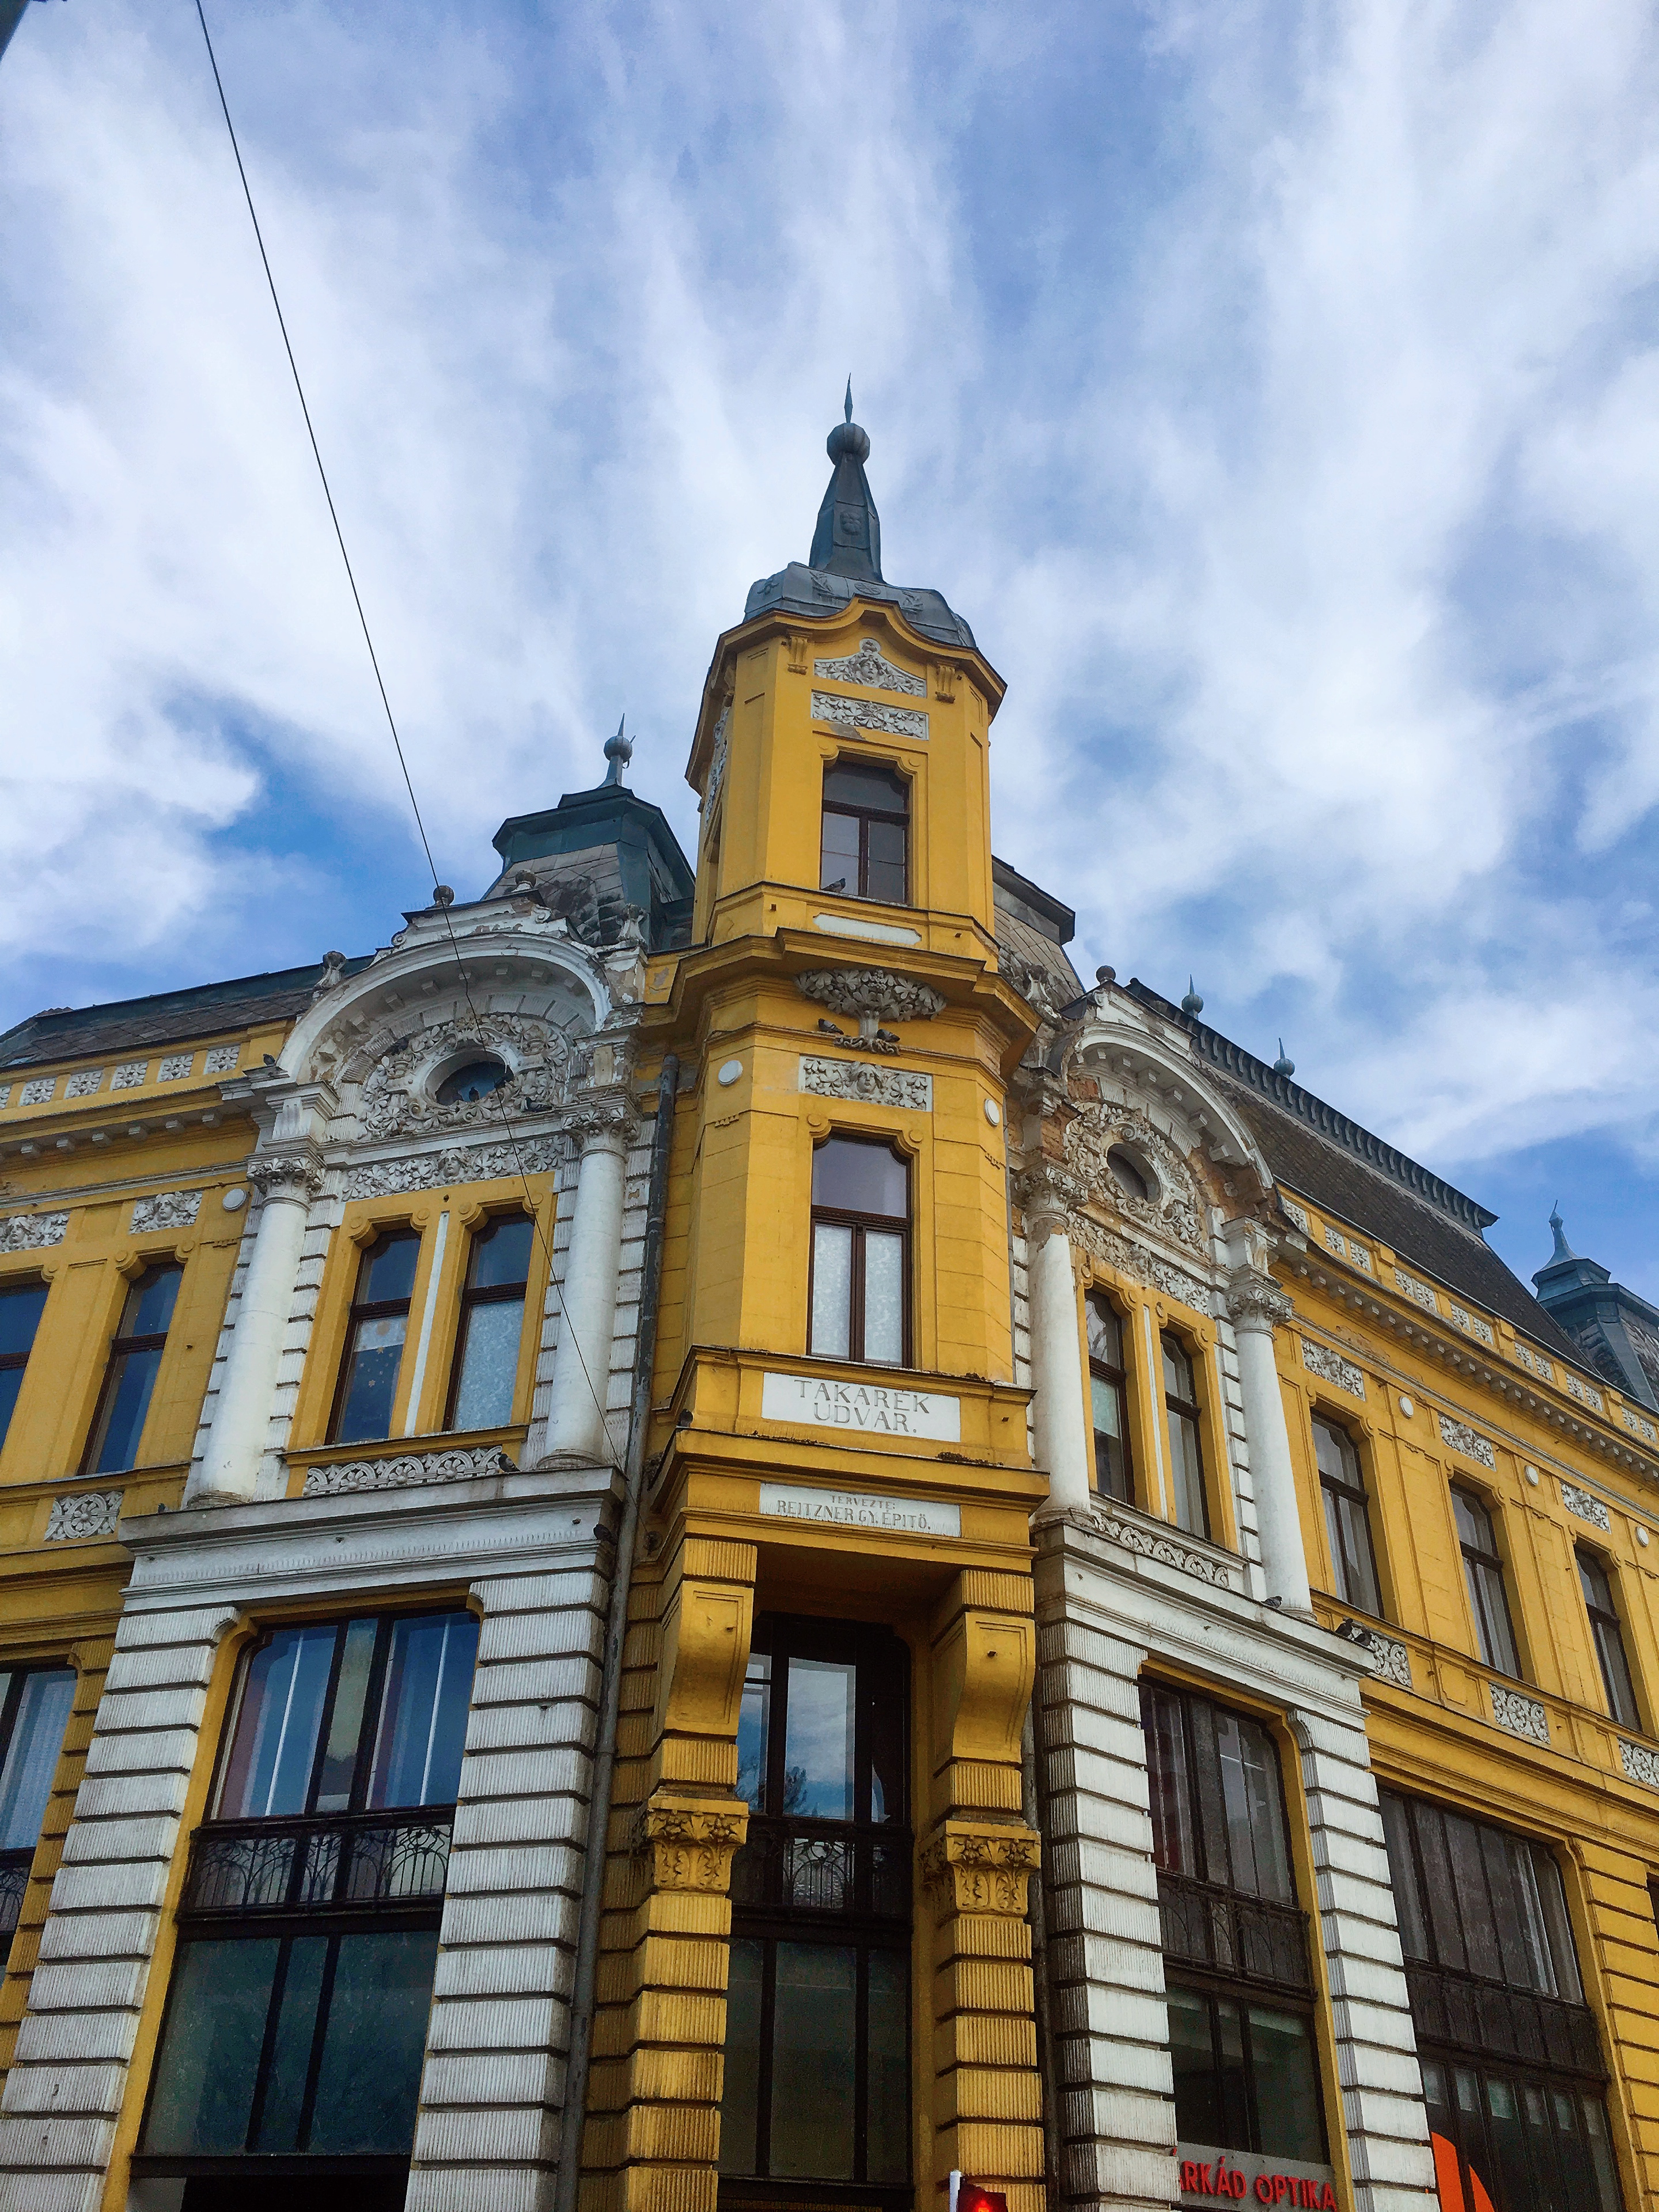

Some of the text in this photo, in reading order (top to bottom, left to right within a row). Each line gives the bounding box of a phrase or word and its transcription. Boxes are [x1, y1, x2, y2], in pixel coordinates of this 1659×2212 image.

[814, 1402, 916, 1433] UDVAR.
[777, 1500, 853, 1521] REITZNER
[859, 1510, 878, 1524] GY.
[830, 1495, 895, 1509] TERVEZTE:
[1173, 2147, 1338, 2212] RKÁD OPTIKA
